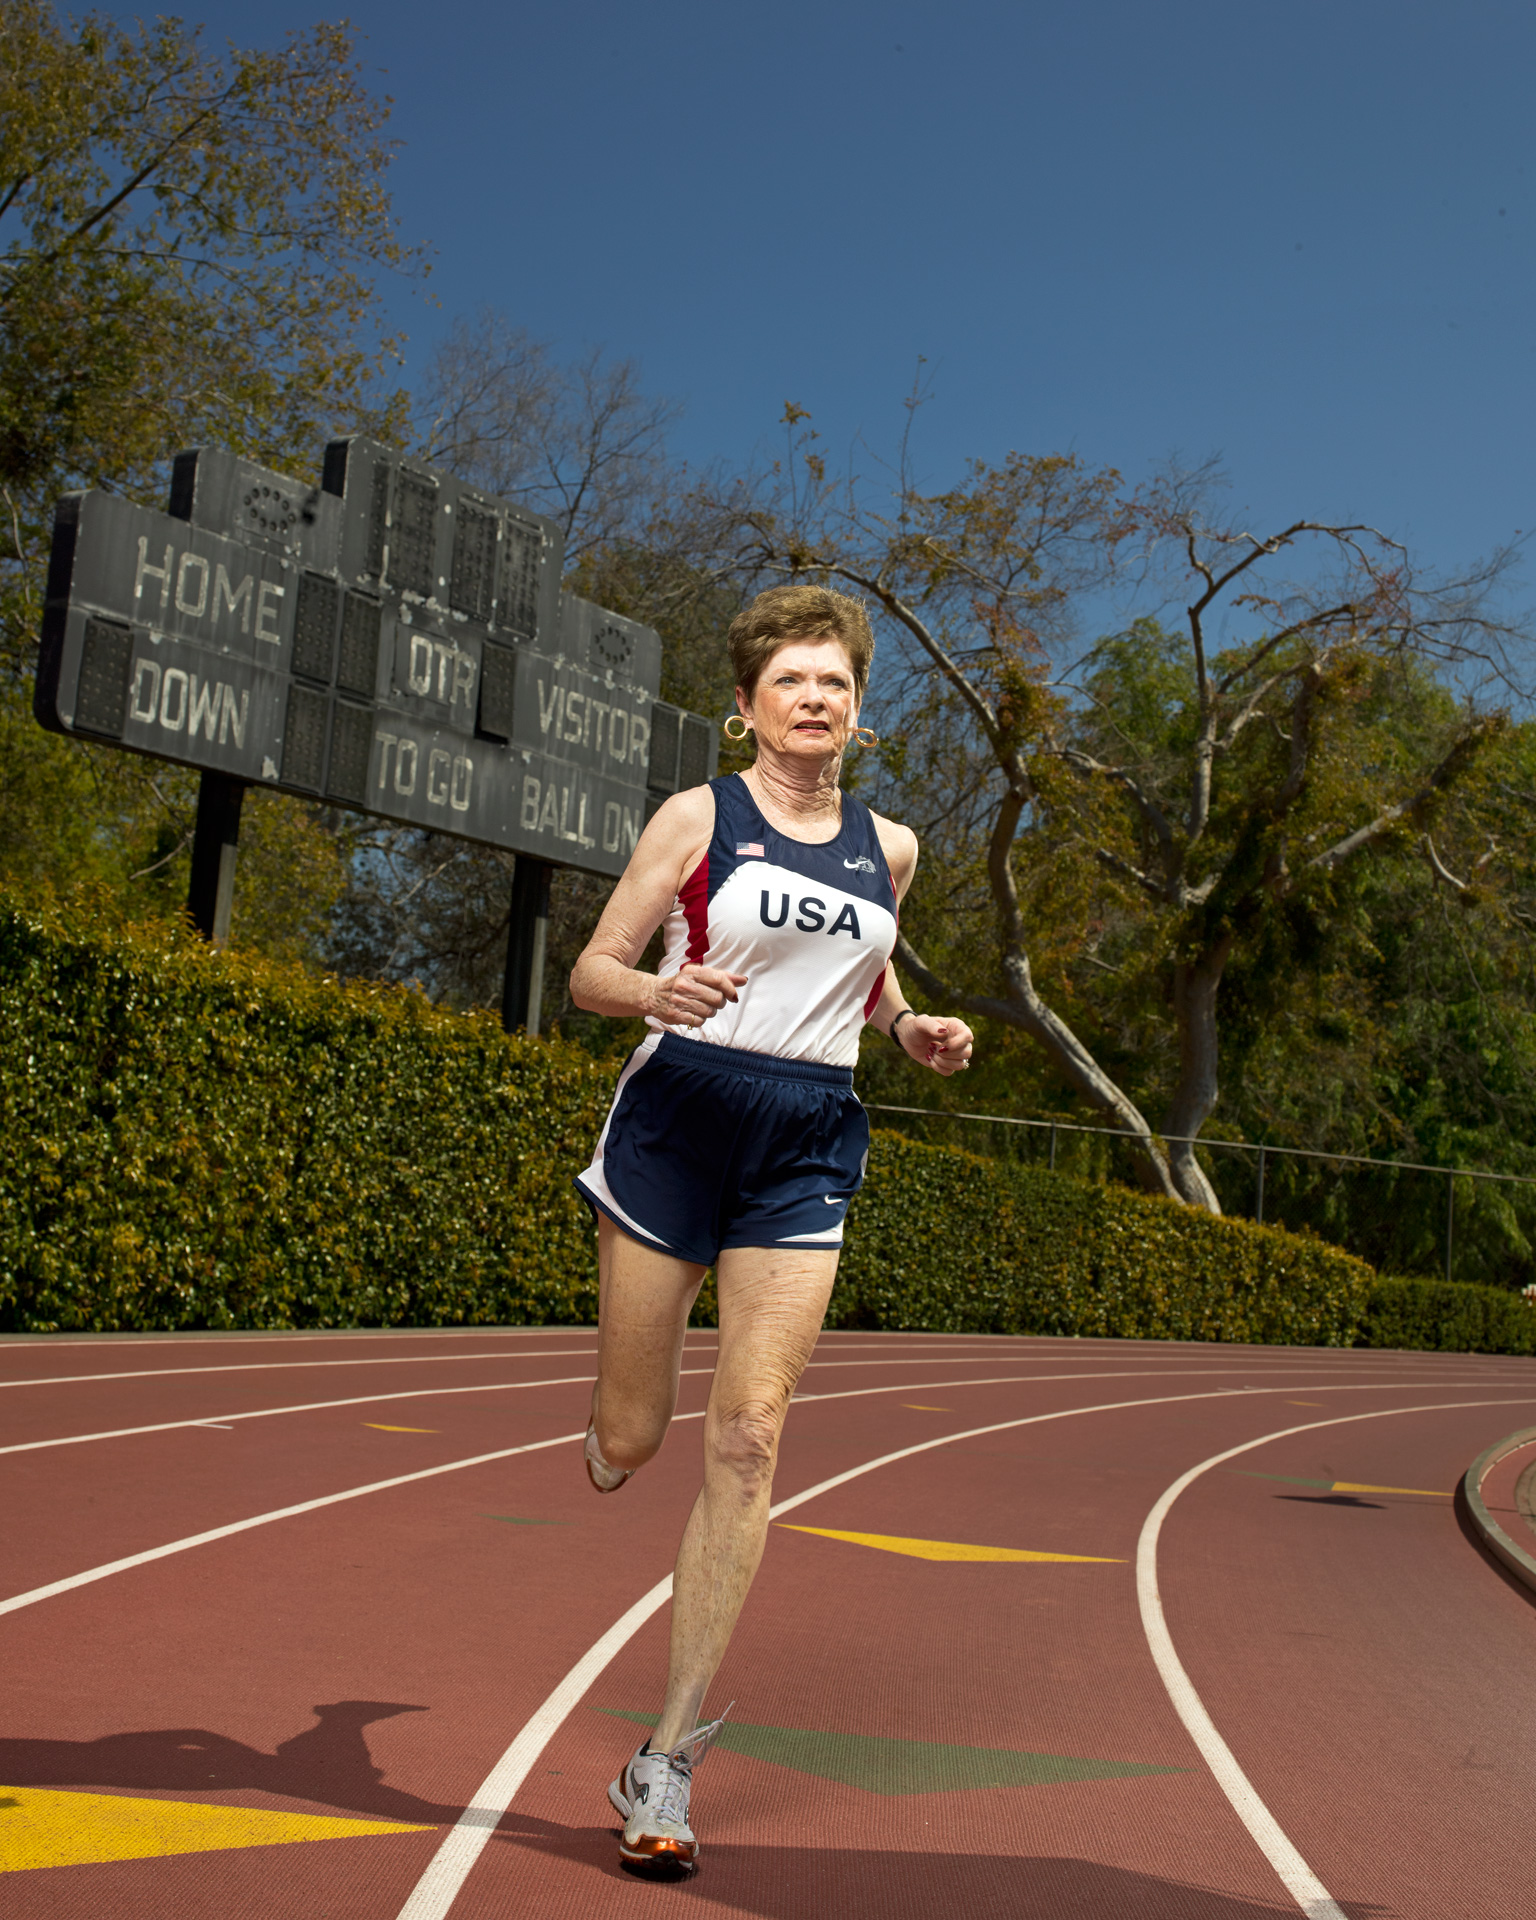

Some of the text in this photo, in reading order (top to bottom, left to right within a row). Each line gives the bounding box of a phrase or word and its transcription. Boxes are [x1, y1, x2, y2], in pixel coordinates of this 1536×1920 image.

[134, 536, 285, 645] HOME
[130, 657, 250, 749] DOWN
[409, 635, 476, 708] QTR
[537, 679, 650, 767] VISITOR
[375, 731, 473, 811] TO GO
[520, 775, 640, 856] BALL ON
[760, 889, 861, 940] USA
